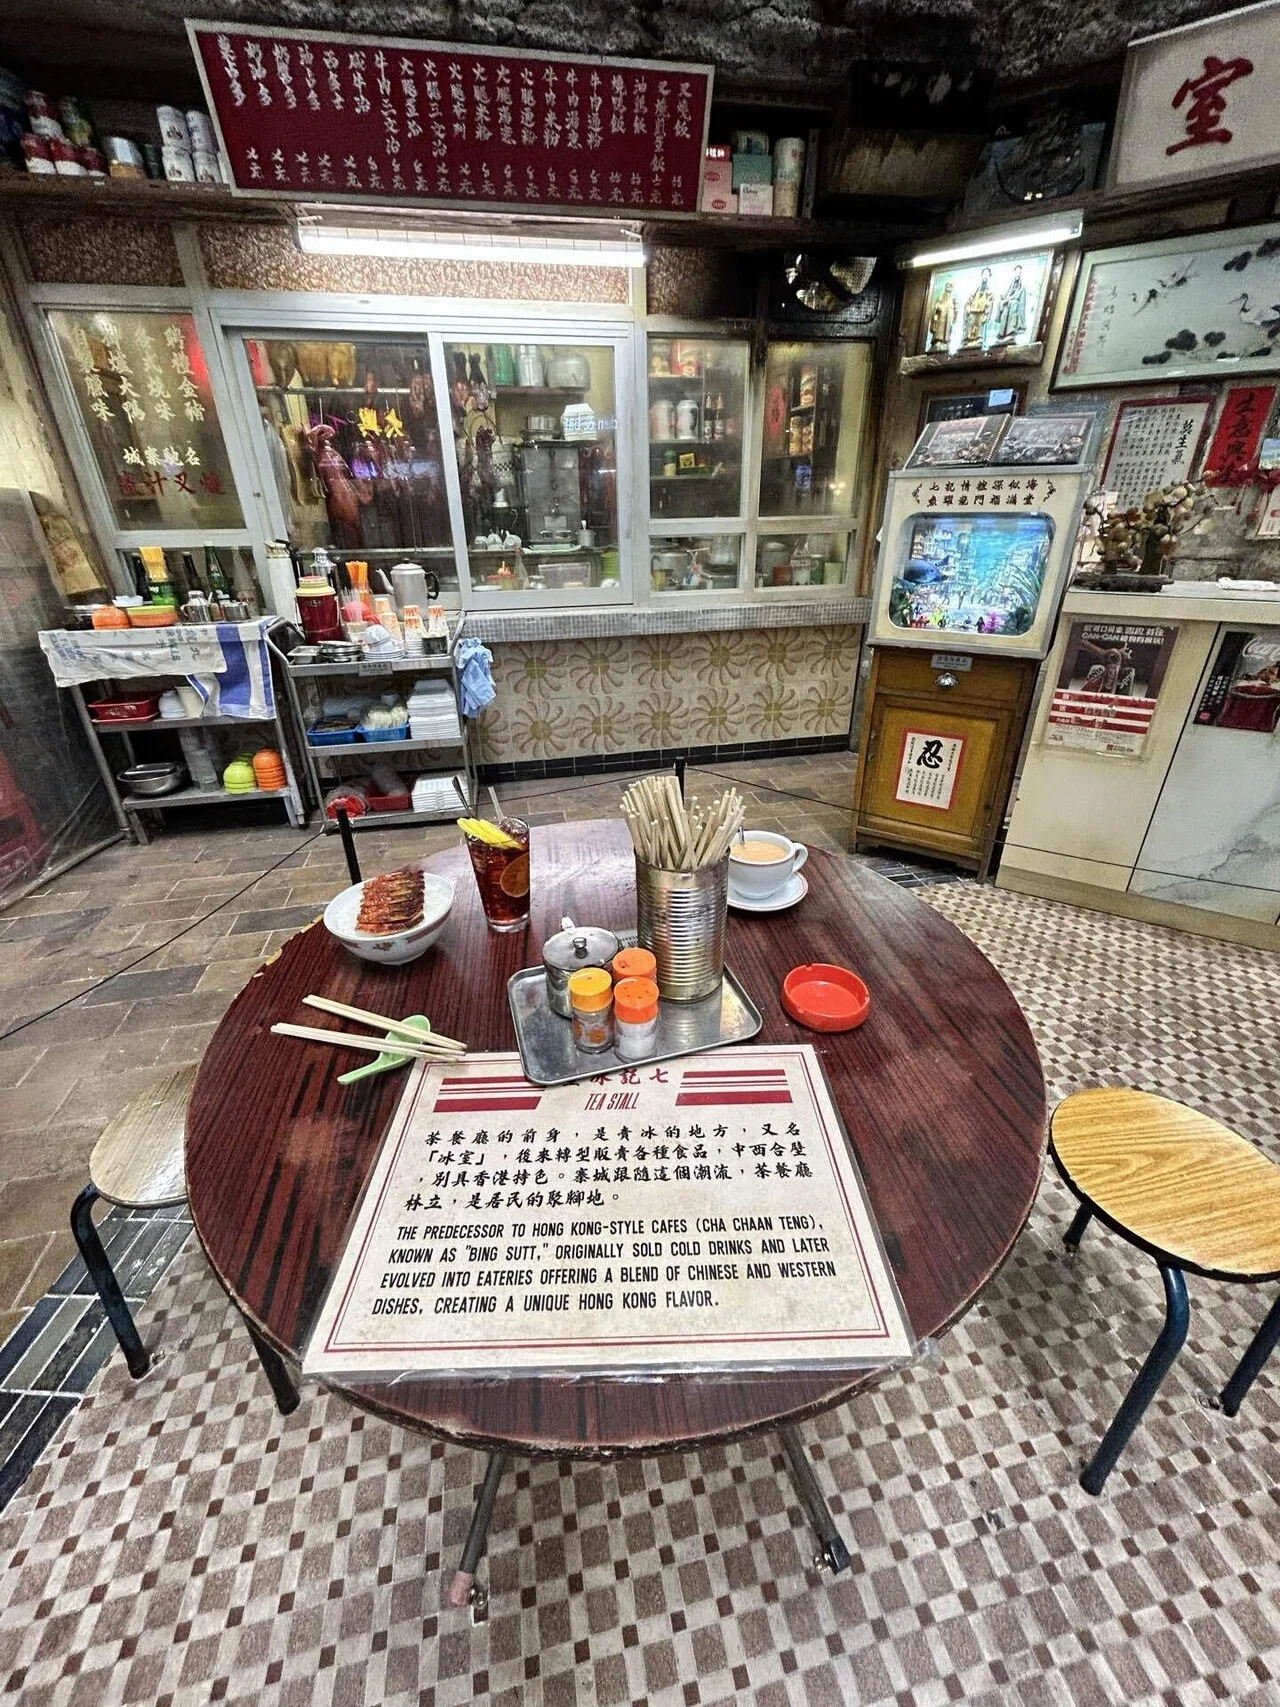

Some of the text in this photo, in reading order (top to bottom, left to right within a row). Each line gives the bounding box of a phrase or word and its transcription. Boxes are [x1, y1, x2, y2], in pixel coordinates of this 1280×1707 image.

[1166, 56, 1254, 157] 室
[1171, 419, 1194, 465] 莫生氣
[916, 739, 943, 769] 忍
[585, 1092, 640, 1110] TEA STALL
[397, 1214, 823, 1240] THE PREDECESSOR TO HONG KONG-STYLE CAFES (CHA CHAAN TENG),
[388, 1237, 830, 1264] KNOWN AS "BING SUTT," ORIGINALLY SOLD COLD DRINKS AND LATER
[380, 1261, 837, 1289] EVOLVED INTO EATERIES OFFERING A BLEND OF CHINESE AND WESTERN
[371, 1290, 719, 1315] DISHES, CREATING A UNIQUE HONG KONG FLAVOR.
